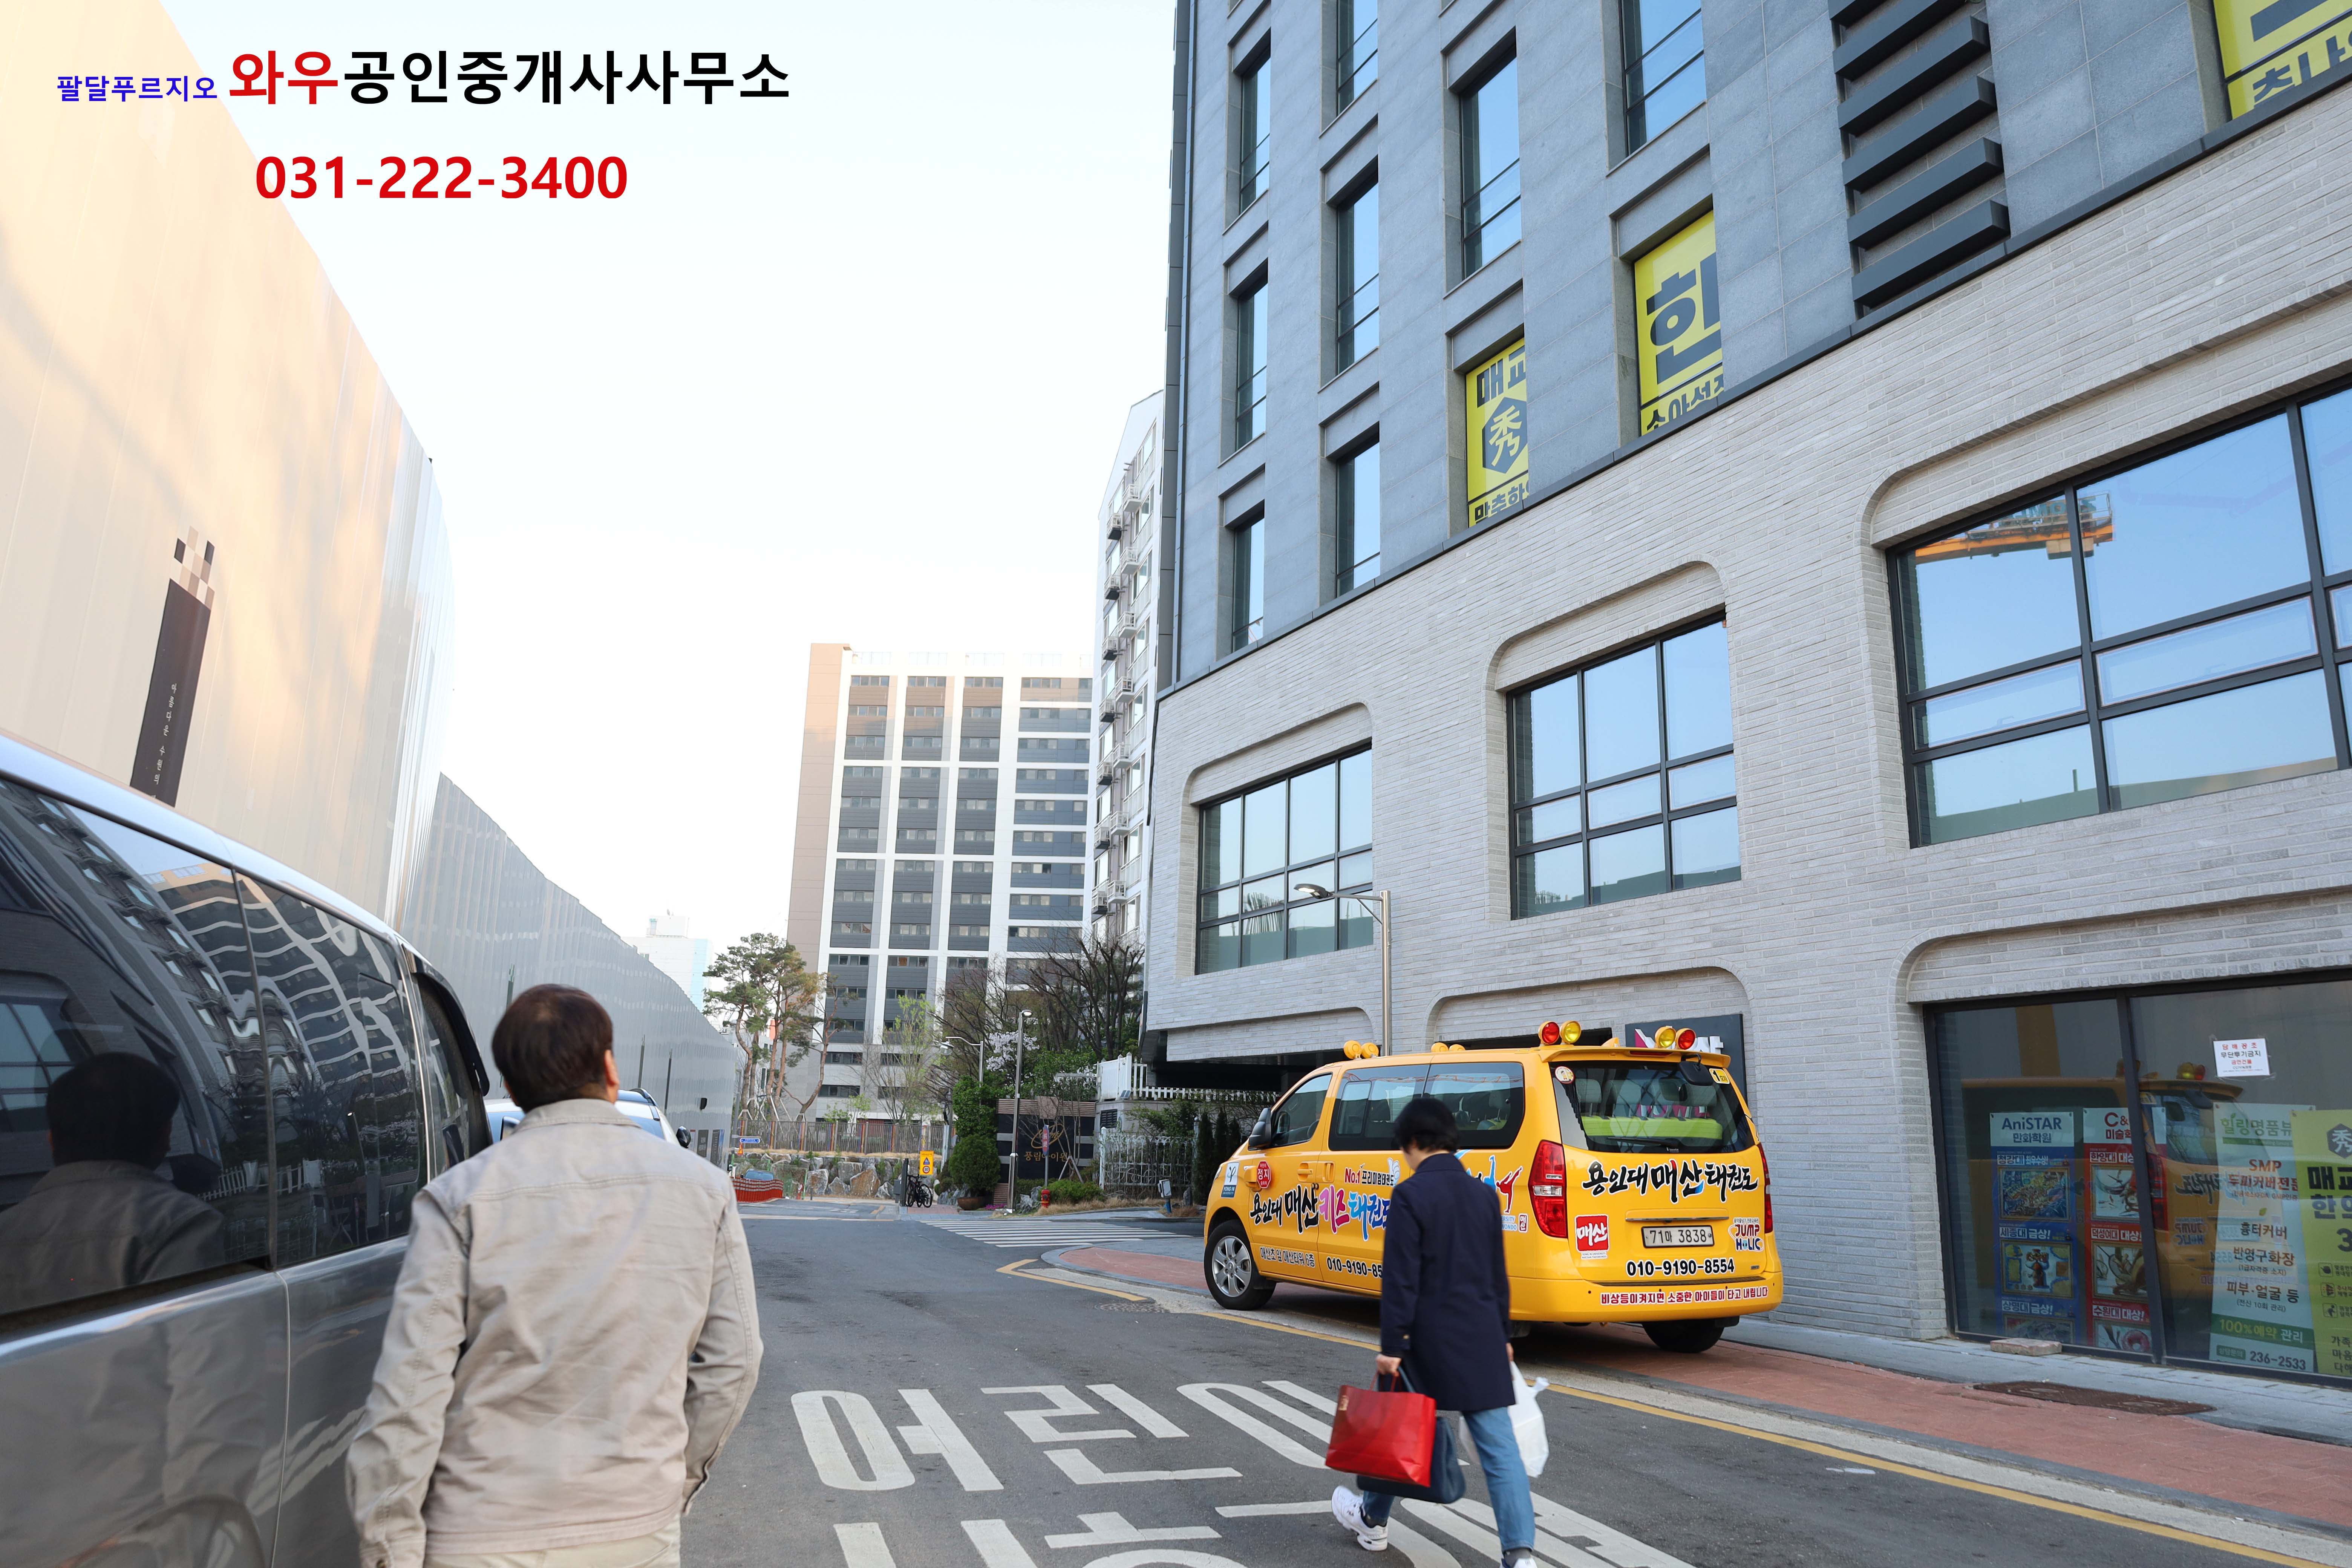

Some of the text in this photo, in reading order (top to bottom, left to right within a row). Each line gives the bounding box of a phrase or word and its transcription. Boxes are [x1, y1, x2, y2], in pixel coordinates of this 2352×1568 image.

[1489, 405, 1522, 467] 秀
[2001, 1117, 2062, 1130] AniSTAR
[2013, 1133, 2052, 1143] 만화학원
[1998, 1155, 2024, 1165] 청강대
[2026, 1155, 2048, 1165] 최우수상!
[2090, 1152, 2116, 1162] 한양대
[2249, 1159, 2282, 1172] SMP
[1257, 1168, 1269, 1180] 정지
[1344, 1168, 1395, 1186] No.1 프리미엄태권도
[1582, 1159, 1759, 1203] 용인대 매산 태권도
[1250, 1192, 1282, 1227] 용인대
[1284, 1184, 1319, 1234] 매산
[1319, 1185, 1350, 1234] 키즈
[1520, 1216, 1526, 1231] 매산
[1735, 1224, 1760, 1237] JUMP
[2240, 1222, 2287, 1240] 흉터커버
[1576, 1222, 1608, 1246] 매산
[1649, 1229, 1707, 1243] 71마 3838
[1999, 1227, 2027, 1238] 세종대
[2028, 1228, 2050, 1240] 금상!
[2091, 1228, 2142, 1242] 덕성여대 대상!
[1260, 1246, 1315, 1268] 매산초 앞 매산타워 6층
[2233, 1246, 2295, 1267] 반영구화장
[1626, 1258, 1735, 1276] 010-9190-8554
[1601, 1286, 1768, 1304] 비상등이켜지면 소중한 아이들이 타고 내립니다
[2226, 1281, 2299, 1303] 피부·얼굴 등
[2002, 1300, 2029, 1313] 상명대
[2031, 1303, 2053, 1315] 금상!
[2237, 1299, 2251, 1307] (전신
[2254, 1301, 2268, 1310] 10회
[2092, 1305, 2145, 1321] 수원대 대상!
[2220, 1319, 2303, 1343] 100%예약 관리
[2249, 1350, 2306, 1370] 236-2533
